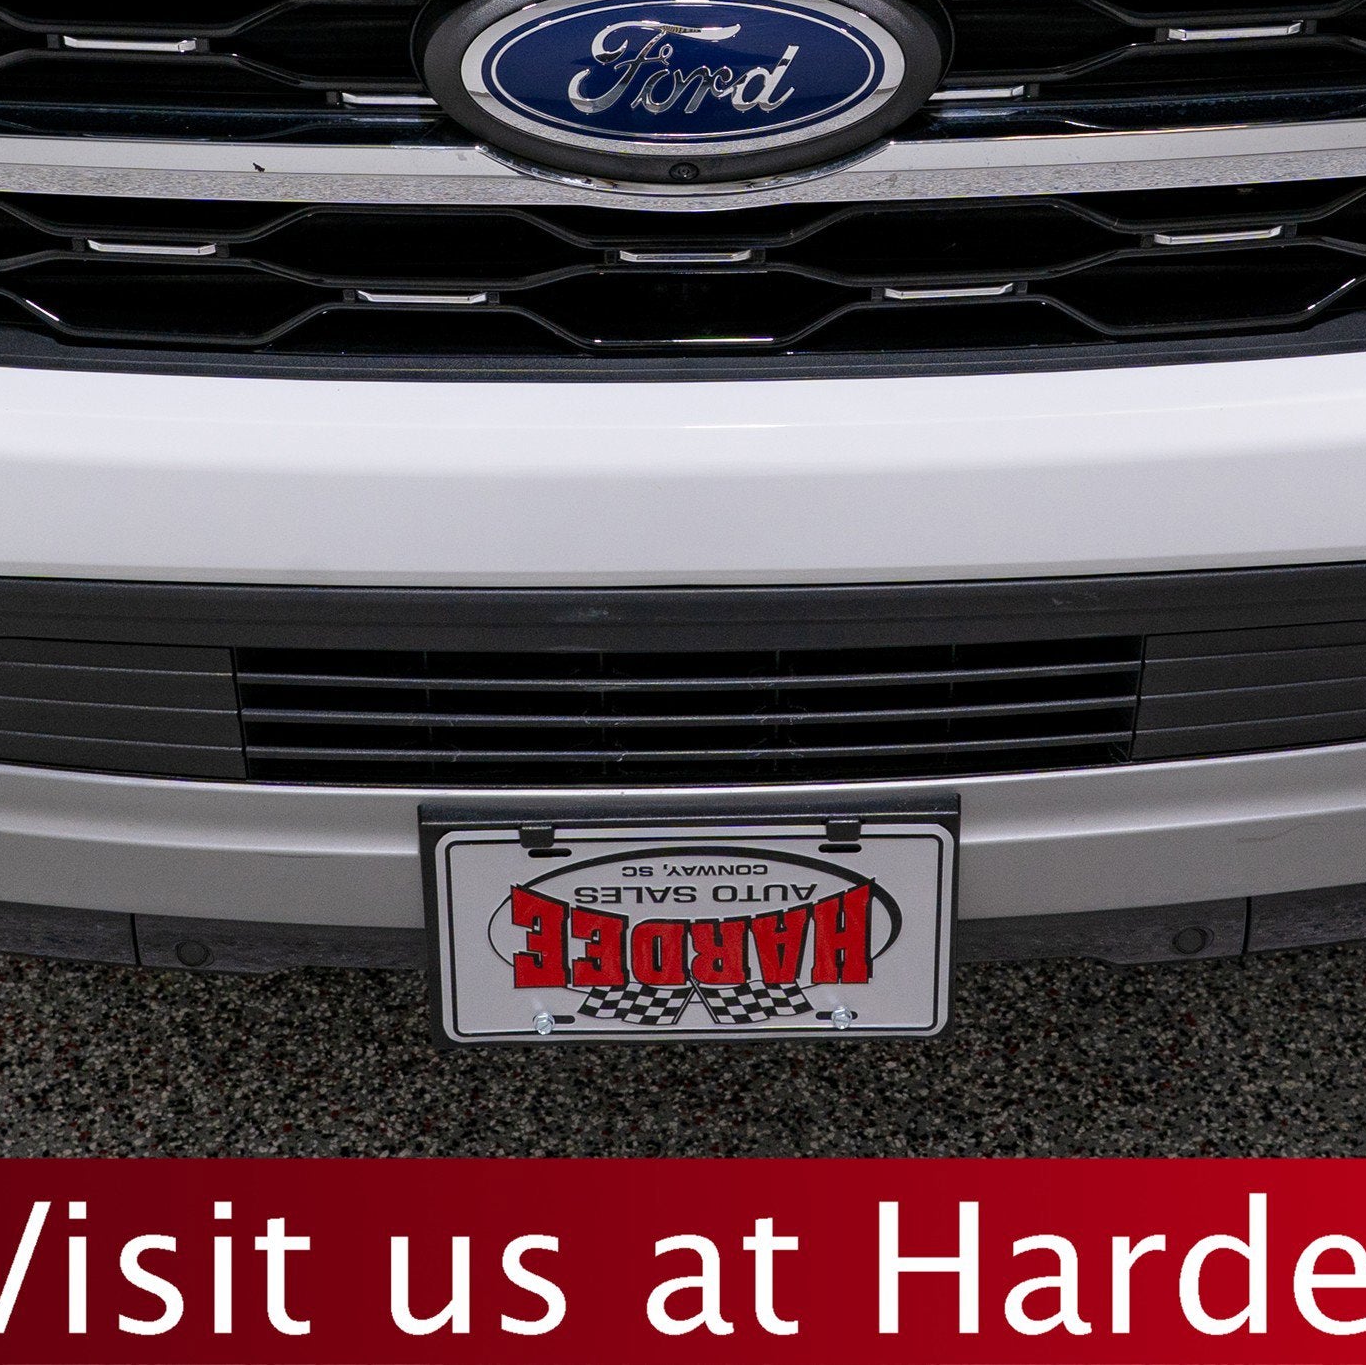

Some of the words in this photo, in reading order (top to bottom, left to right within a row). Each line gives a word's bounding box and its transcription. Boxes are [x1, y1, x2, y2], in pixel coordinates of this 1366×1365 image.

[568, 21, 800, 114] Ford
[621, 864, 654, 877] SC
[662, 863, 769, 876] CONWAY,
[573, 885, 697, 904] SALES
[712, 882, 818, 902] AUTO
[510, 877, 876, 989] HARDEE
